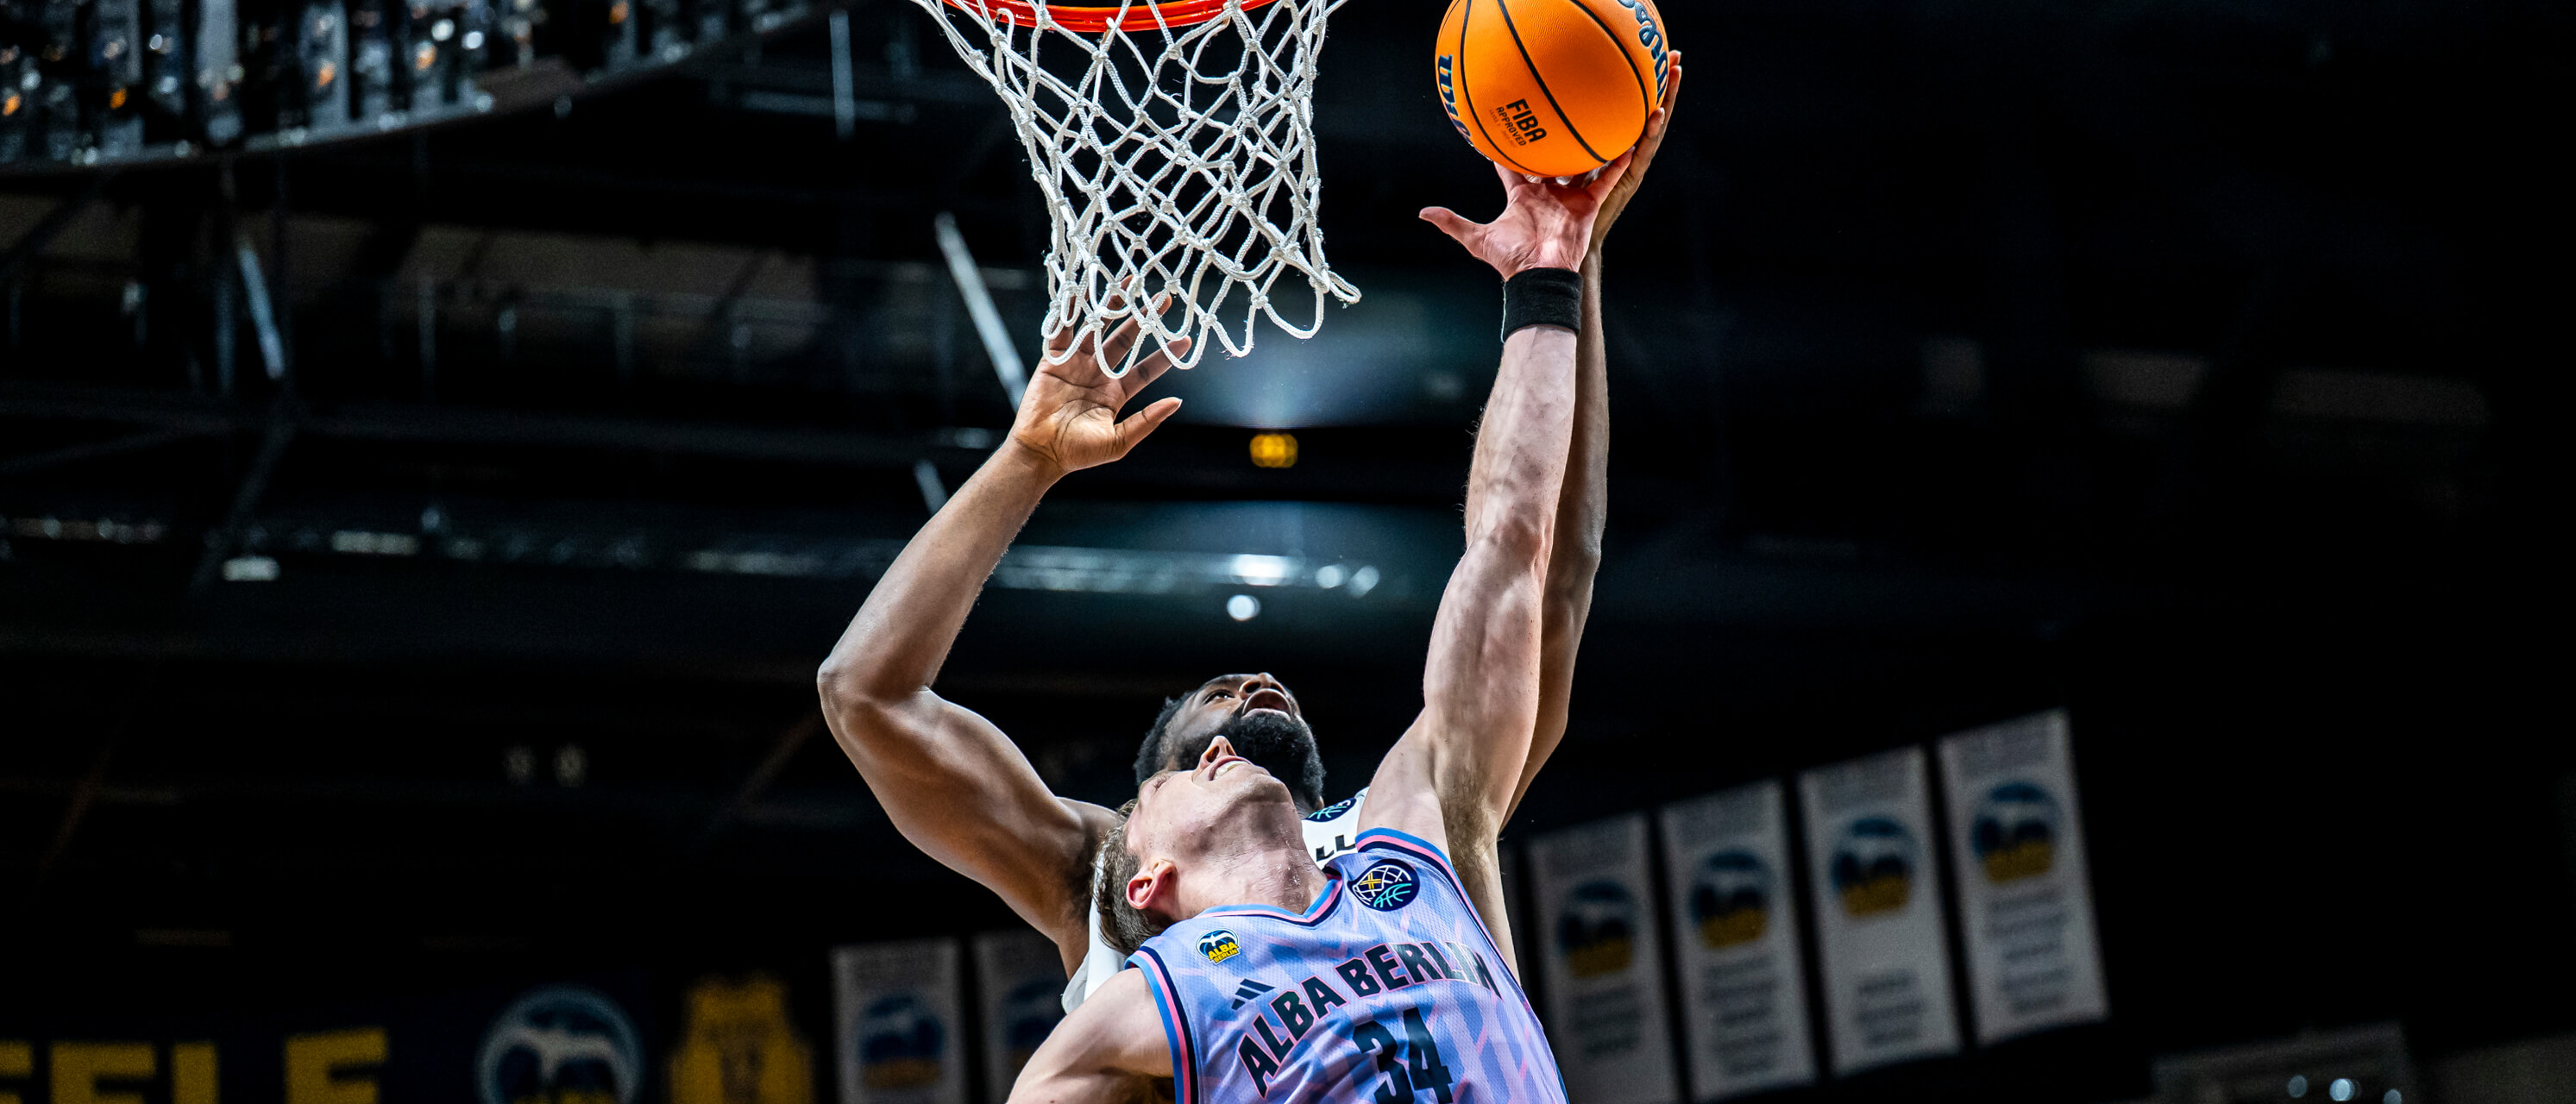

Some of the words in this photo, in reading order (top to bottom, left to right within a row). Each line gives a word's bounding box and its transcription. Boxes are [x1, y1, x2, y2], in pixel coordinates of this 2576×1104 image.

[1496, 106, 1527, 146] APPROVED
[1506, 98, 1548, 143] FIBA
[1208, 941, 1239, 960] ALBA
[1213, 948, 1239, 963] BERLIN
[1236, 975, 1349, 1100] ALBA
[1334, 941, 1505, 1002] BERLIN
[1352, 1007, 1454, 1104] 34
